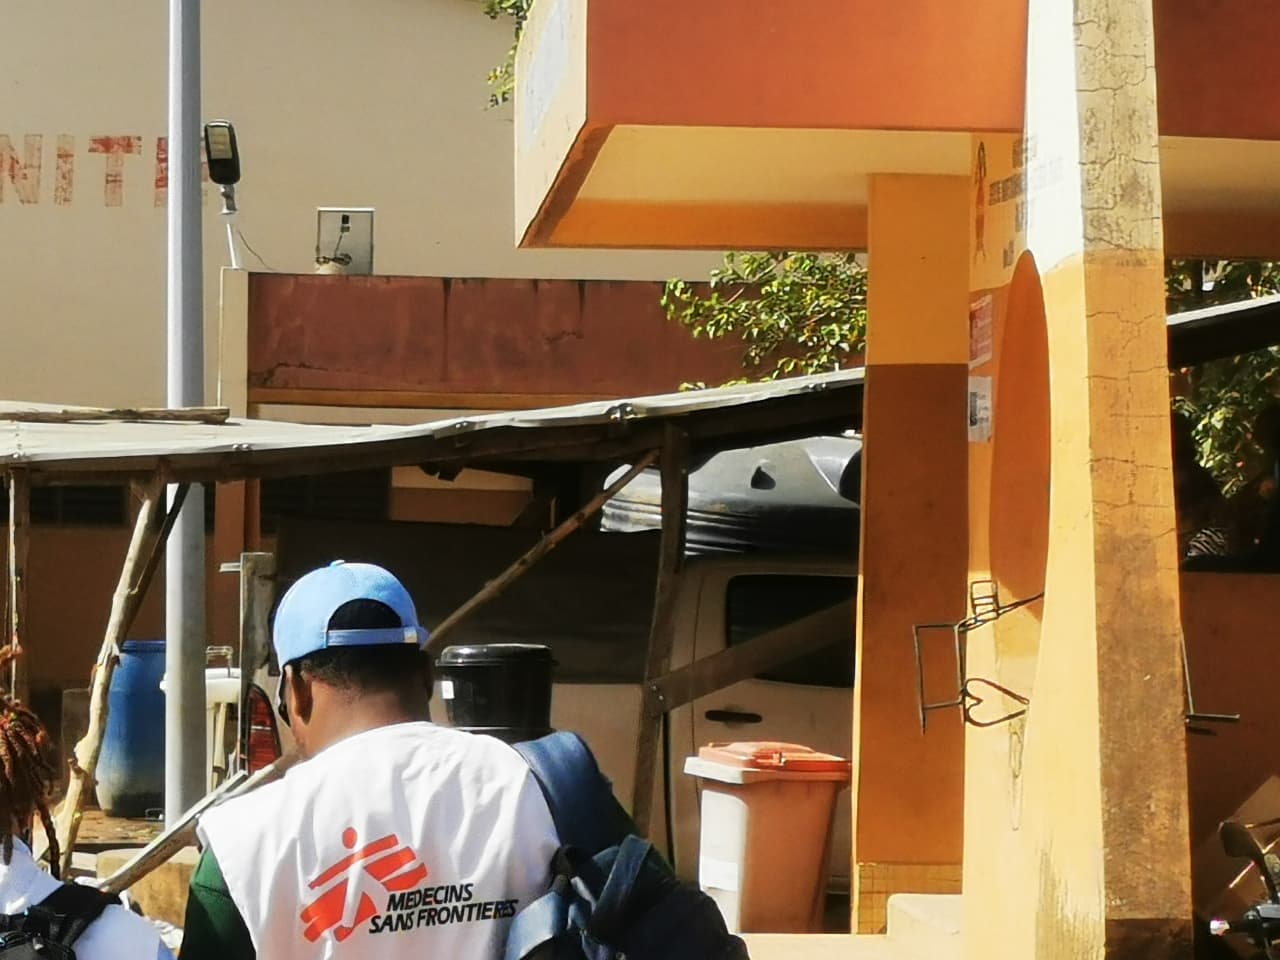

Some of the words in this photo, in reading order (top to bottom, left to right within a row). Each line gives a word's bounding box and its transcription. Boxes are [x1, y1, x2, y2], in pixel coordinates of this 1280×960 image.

[386, 883, 474, 912] MEDECINS
[369, 911, 415, 934] SANS
[417, 899, 519, 928] FRONTIERES
